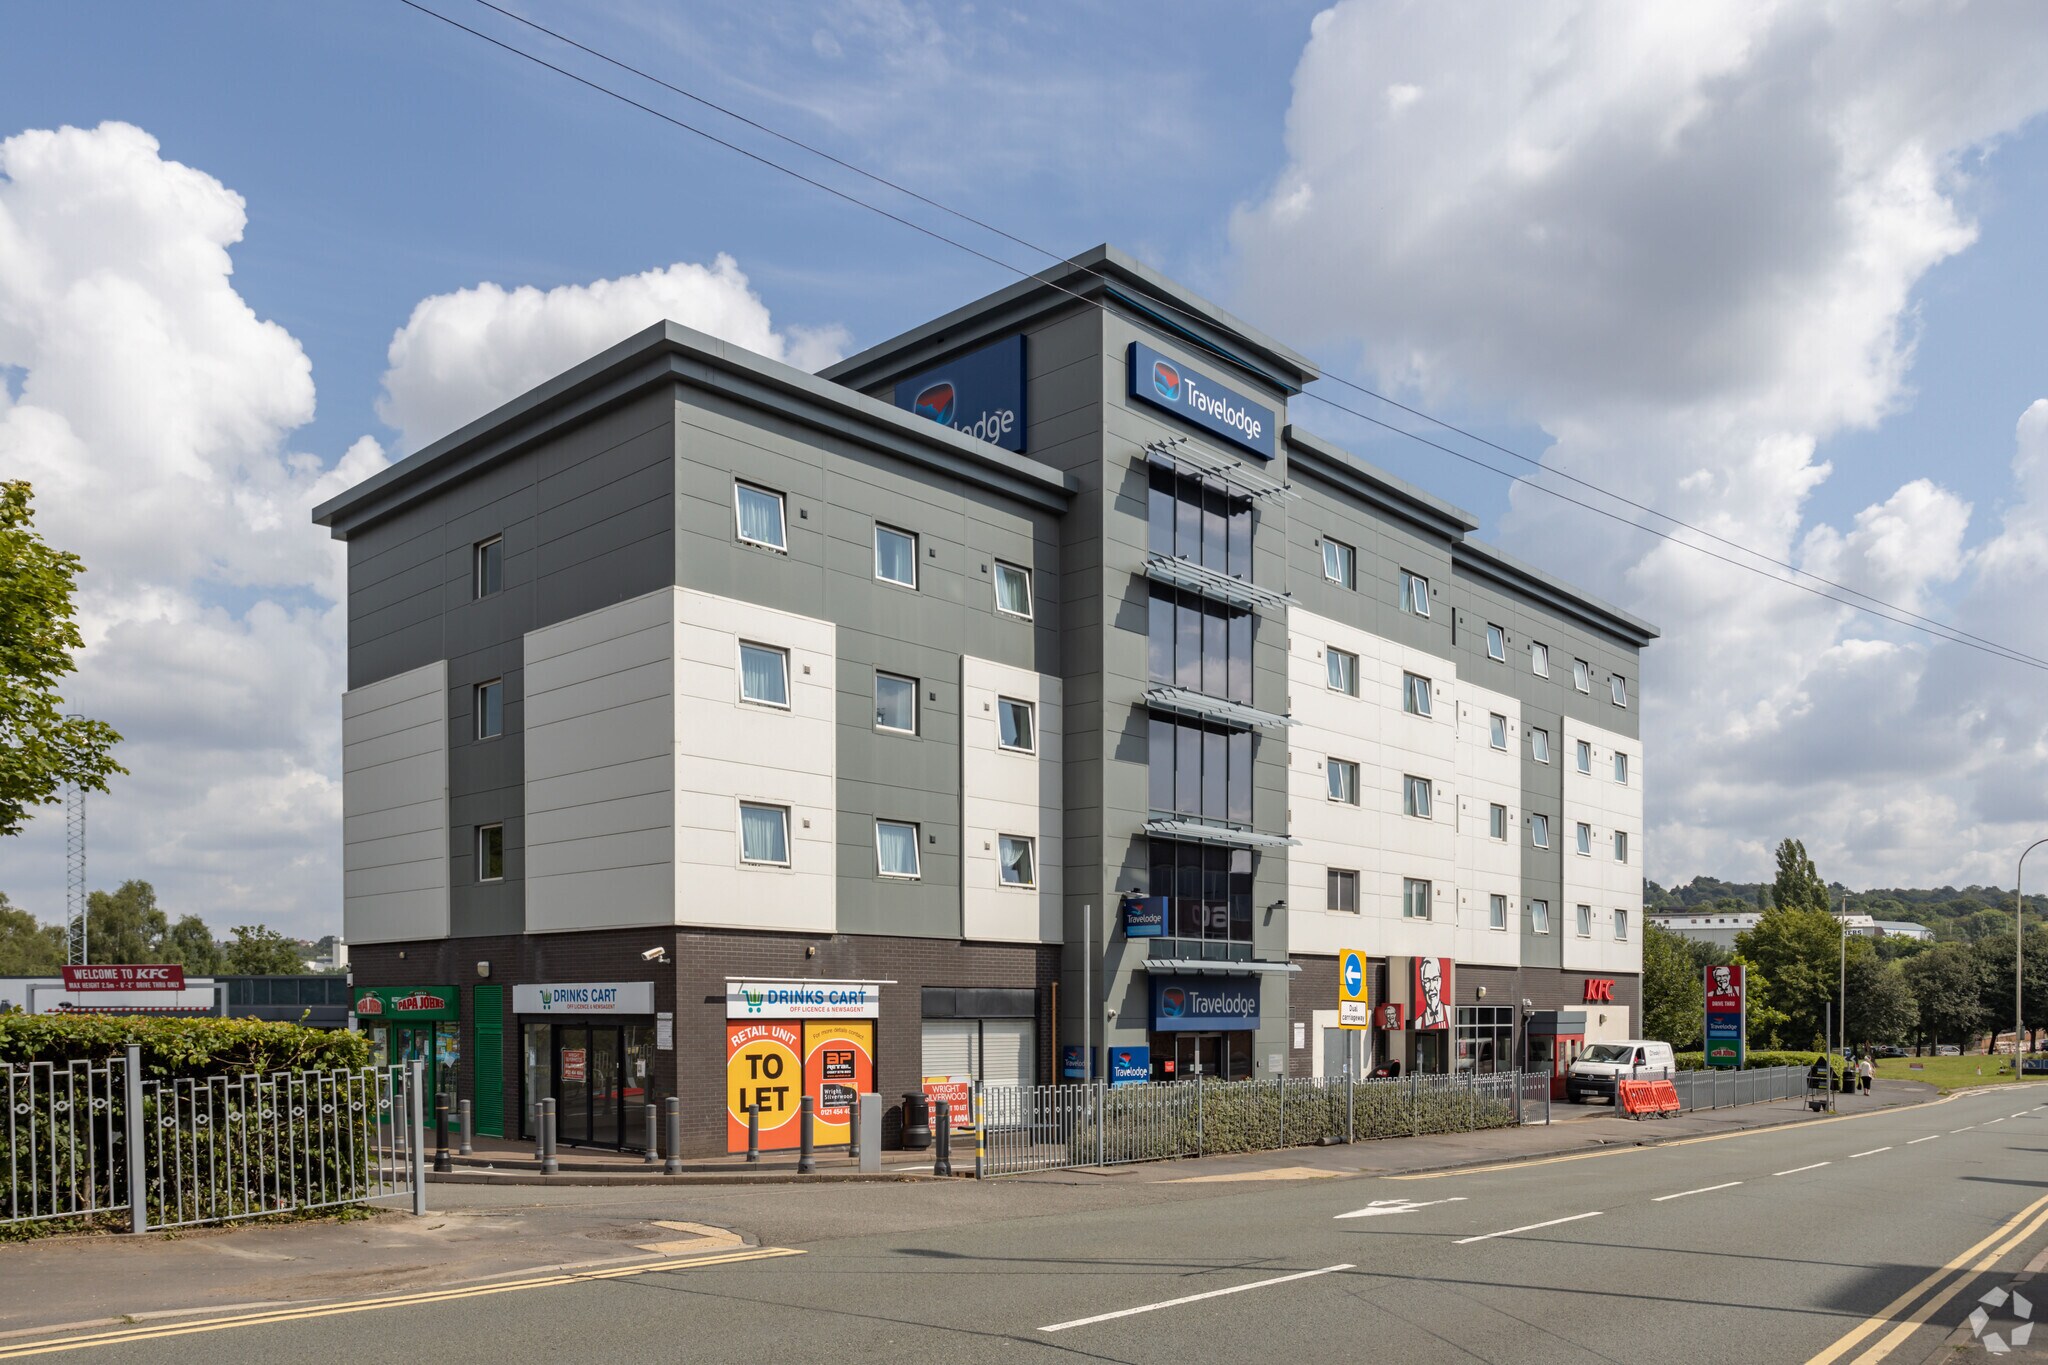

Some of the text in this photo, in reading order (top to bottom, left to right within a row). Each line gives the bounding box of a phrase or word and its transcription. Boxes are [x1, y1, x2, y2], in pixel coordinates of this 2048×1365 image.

[1184, 378, 1261, 440] Travelodge
[1127, 914, 1162, 924] Travelodge
[73, 968, 169, 980] WELCOME TO KFC
[101, 981, 114, 989] 2.5m
[136, 981, 151, 989] DRIVE
[1584, 979, 1616, 1000] KFC
[554, 988, 617, 1002] DRINKS CART
[768, 990, 866, 1005] DRINKS CART
[398, 996, 418, 1010] PAPA
[419, 996, 444, 1009] JOHNS
[1189, 992, 1255, 1018] Travelodge
[1349, 1004, 1358, 1012] Dual
[1342, 1014, 1364, 1023] carriageway
[730, 1025, 797, 1047] RETAIL UNIT
[848, 1029, 864, 1040] contact
[745, 1053, 783, 1079] TO
[1114, 1066, 1148, 1078] Travelodge
[931, 1084, 960, 1093] WRIGHT
[740, 1086, 789, 1113] LET
[953, 1114, 968, 1122] 4004
